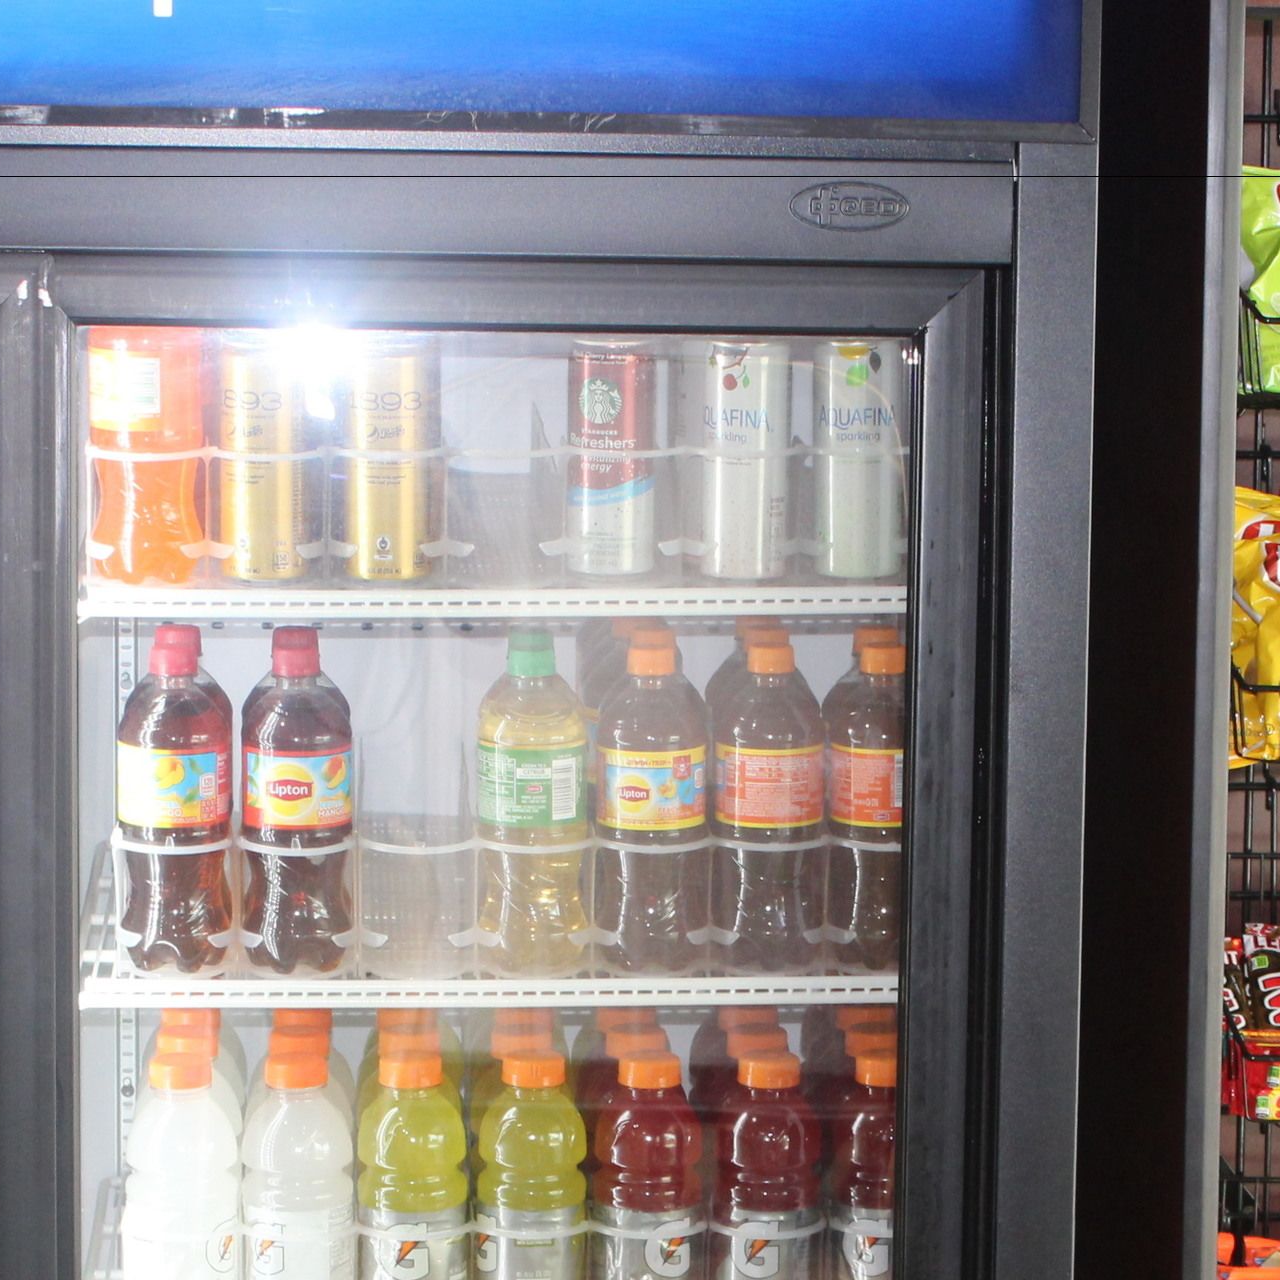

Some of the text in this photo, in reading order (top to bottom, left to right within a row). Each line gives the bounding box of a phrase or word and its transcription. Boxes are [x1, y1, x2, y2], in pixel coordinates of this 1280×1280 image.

[570, 432, 636, 449] Refreshers
[835, 432, 881, 443] sparkling
[269, 783, 309, 797] Lipton
[618, 788, 648, 801] Lipton
[645, 1217, 691, 1278] G
[734, 1218, 781, 1279] G
[841, 1218, 889, 1278] G
